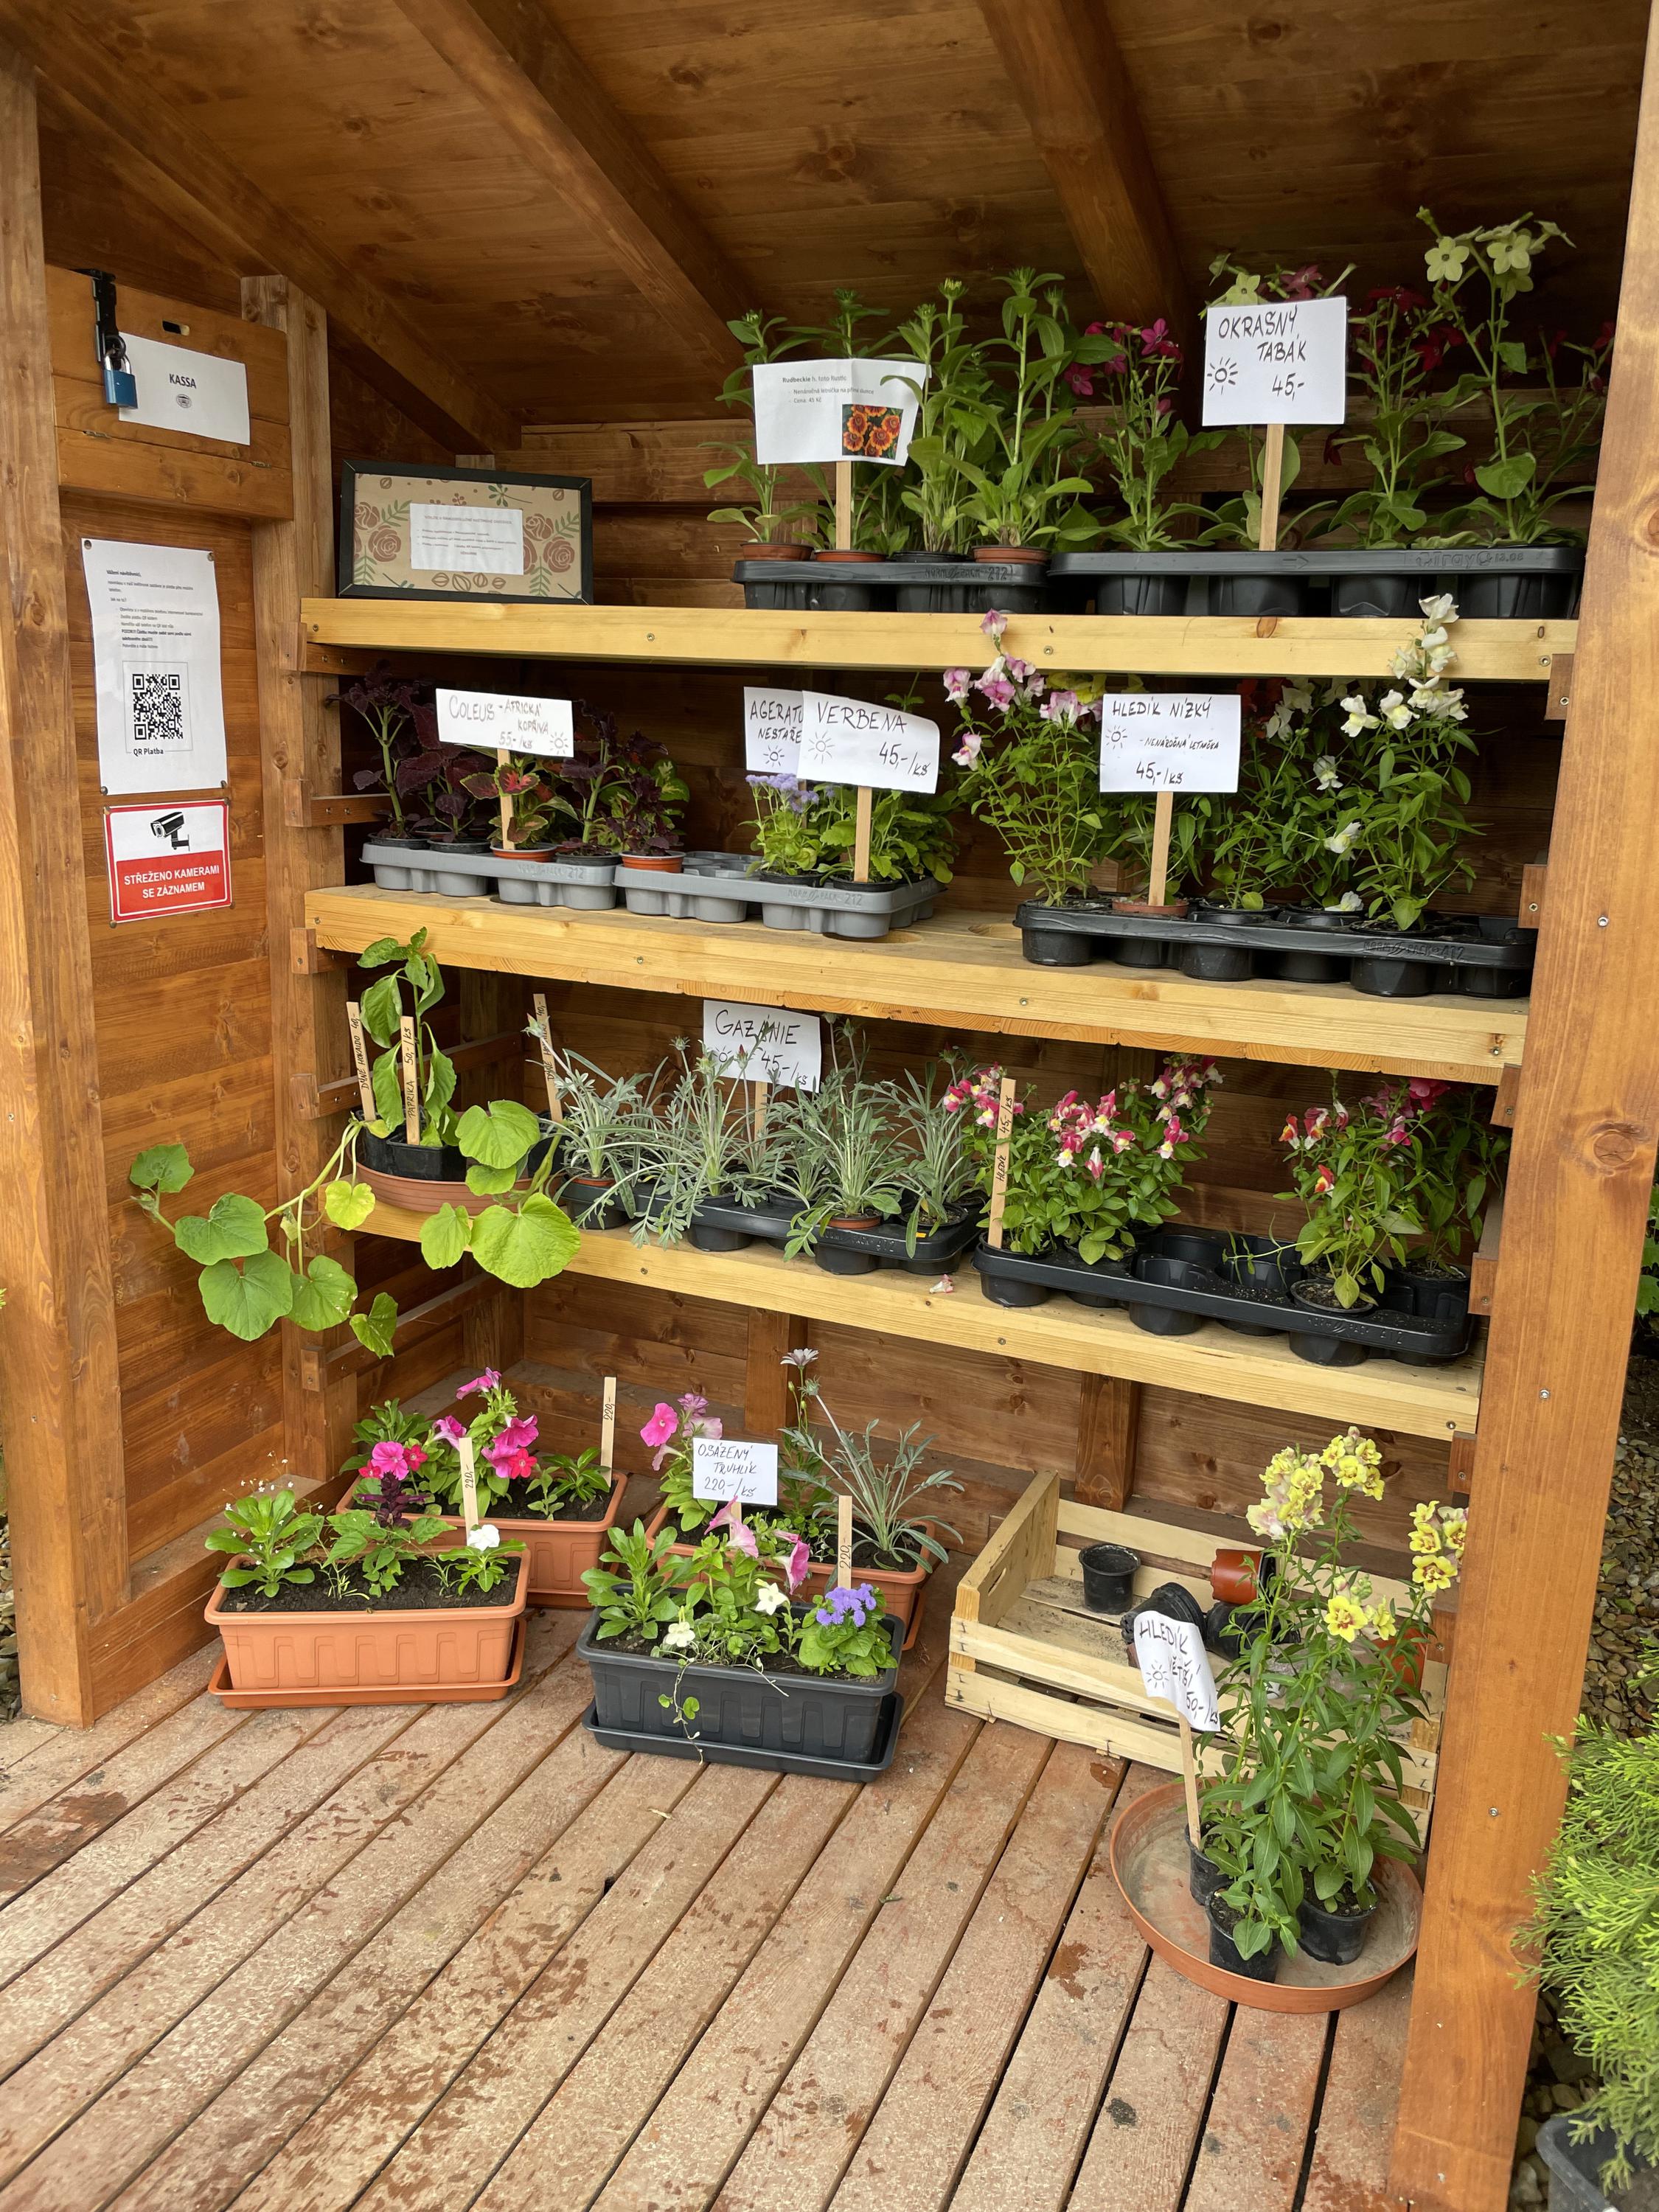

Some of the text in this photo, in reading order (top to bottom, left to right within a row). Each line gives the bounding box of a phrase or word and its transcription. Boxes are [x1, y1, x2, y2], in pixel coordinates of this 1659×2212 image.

[169, 373, 197, 389] KASSA
[1271, 373, 1304, 400] 45,-
[449, 695, 495, 722] COLEUS
[818, 701, 907, 734] VERBENA
[1112, 697, 1211, 719] HLEDÍK NÍZKÝ
[133, 746, 164, 757] QR Platba
[124, 865, 220, 886] STŘEŽENO KAMERAMI
[142, 882, 205, 899] SE ZÁZNAMEM
[407, 1079, 415, 1119] PAPRIKA
[698, 1442, 753, 1461] OSÁZENÝ
[714, 1461, 757, 1475] TRUHLÍK
[1139, 1619, 1188, 1655] HLEDÍK
